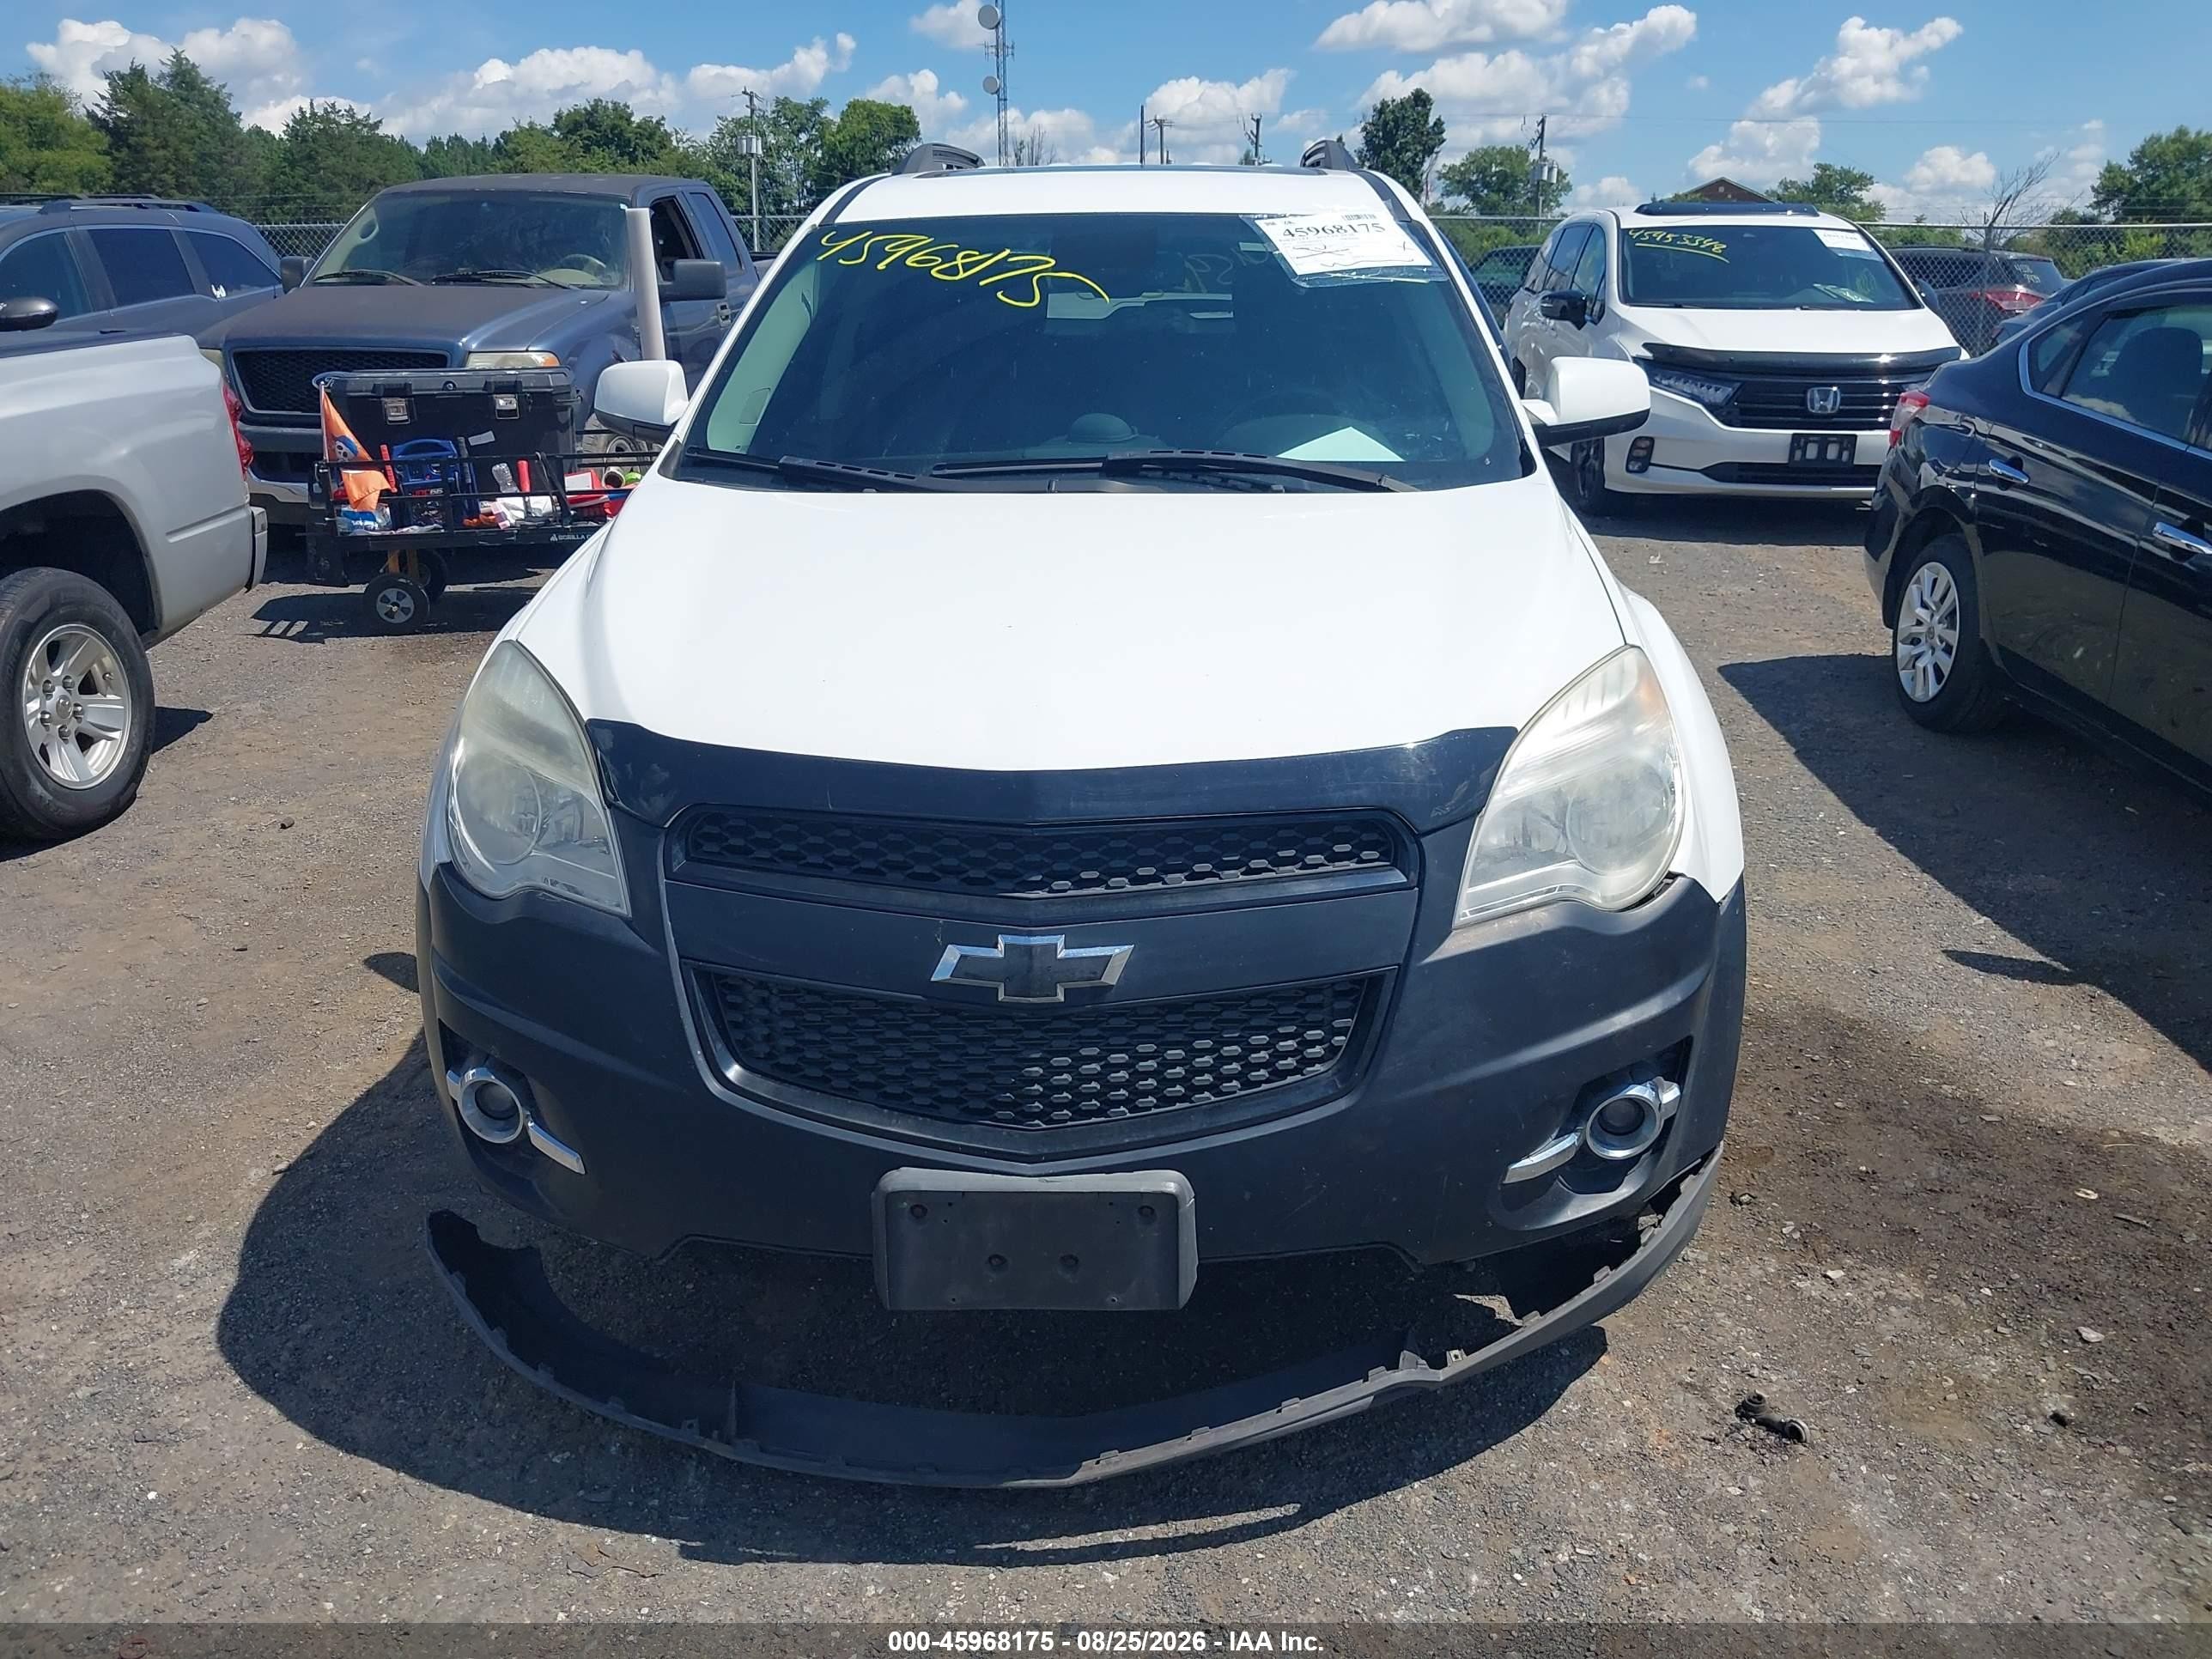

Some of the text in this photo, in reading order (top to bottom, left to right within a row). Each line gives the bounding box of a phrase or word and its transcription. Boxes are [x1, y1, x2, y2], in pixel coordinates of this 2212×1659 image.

[1283, 222, 1386, 237] 45968175
[1628, 228, 1727, 253] 45953348
[817, 230, 1109, 307] 45968175
